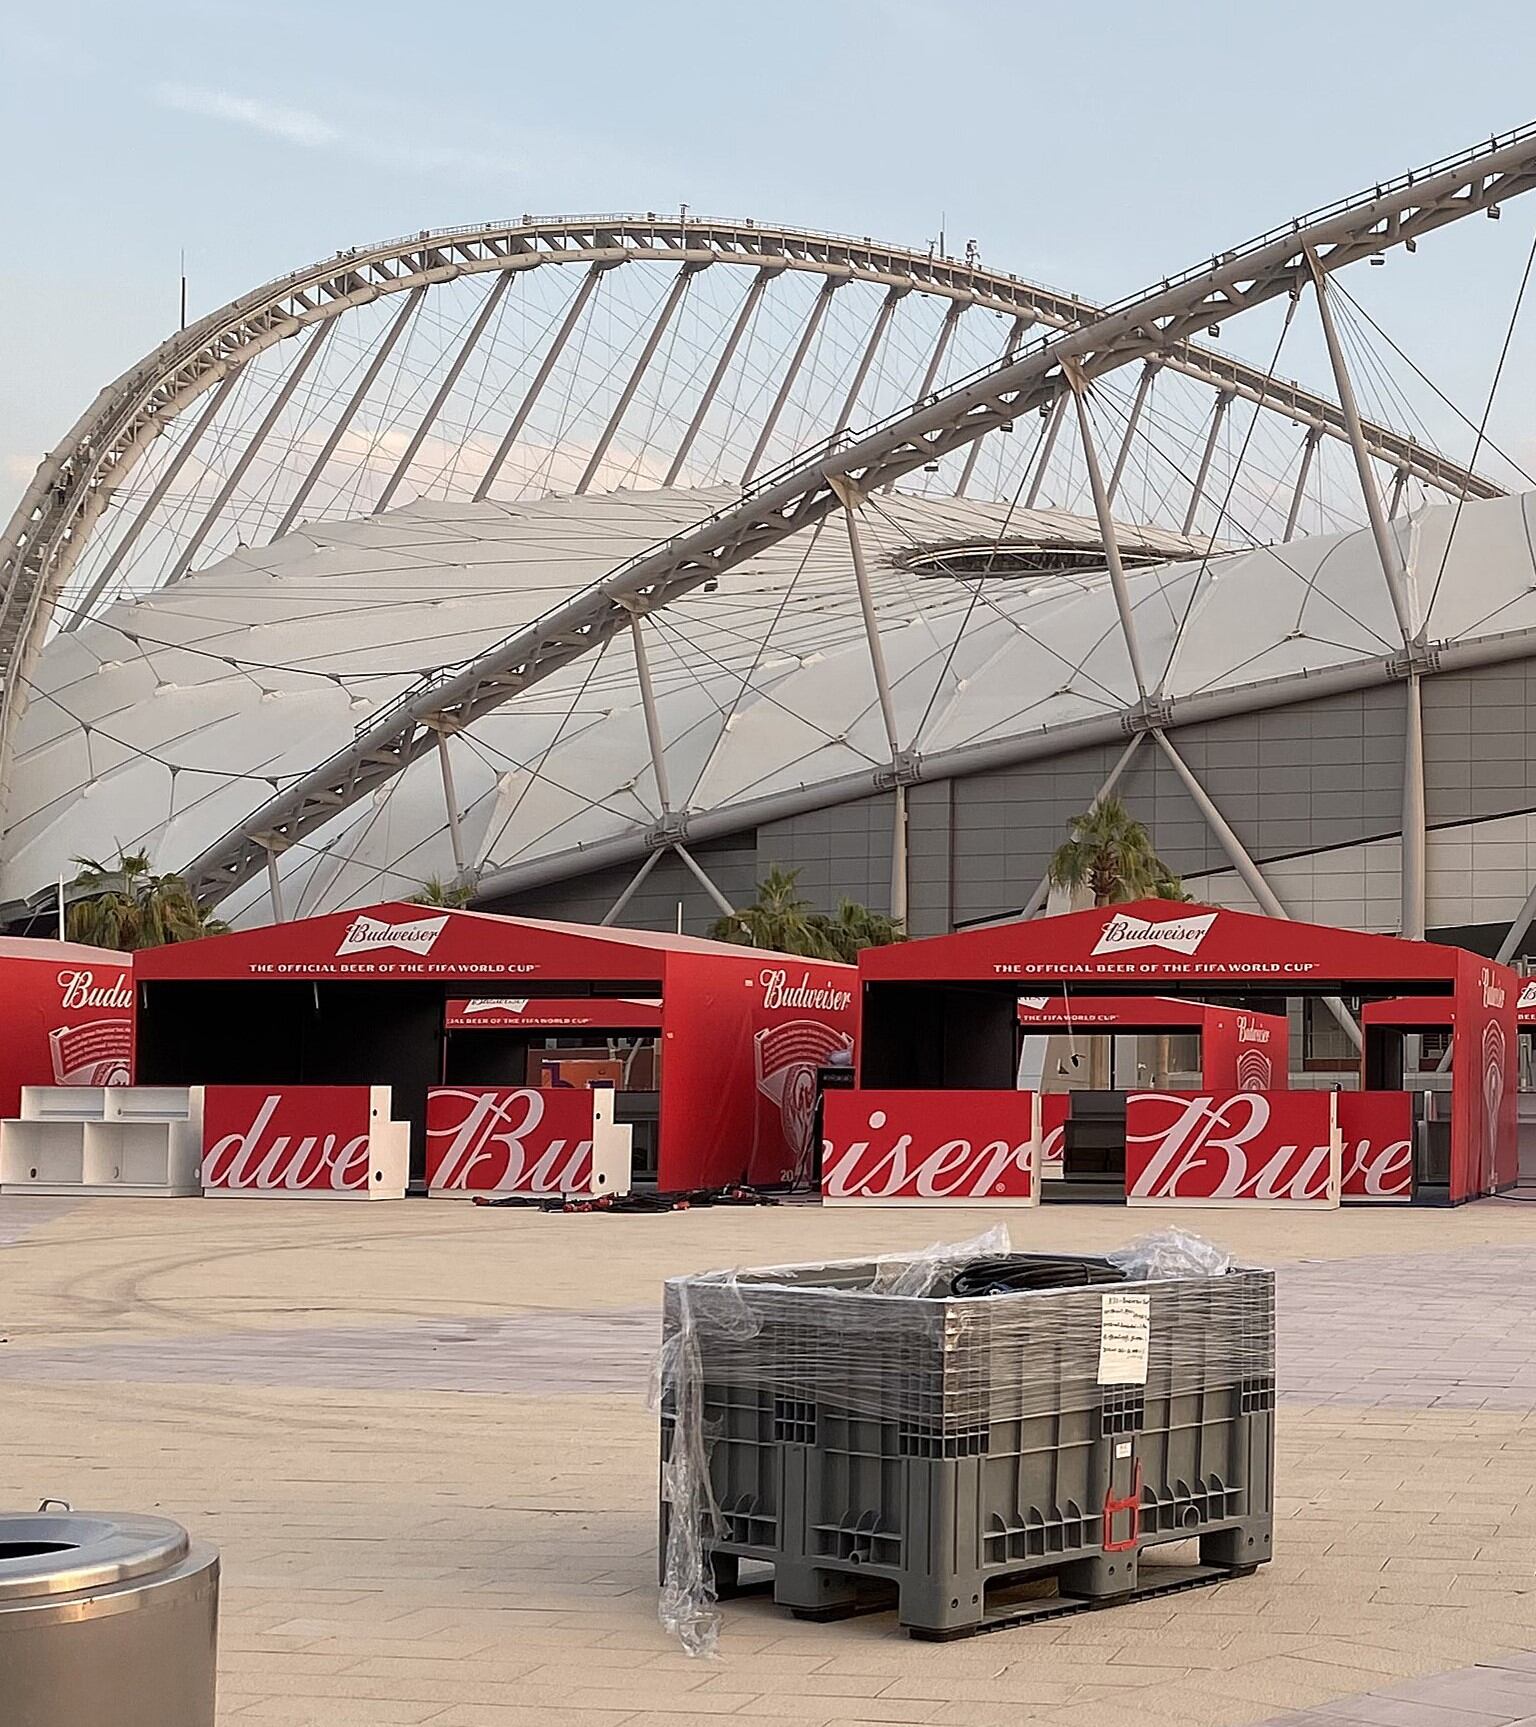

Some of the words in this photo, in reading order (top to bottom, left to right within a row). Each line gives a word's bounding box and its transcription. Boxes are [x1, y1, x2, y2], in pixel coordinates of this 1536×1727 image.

[345, 922, 440, 943] Budweiser
[1101, 922, 1206, 943] Budweiser
[249, 964, 274, 973] THE
[277, 964, 337, 973] OFFICIAL
[340, 964, 375, 973] BEER
[378, 964, 396, 973] OF
[398, 964, 424, 973] THE
[428, 964, 455, 973] FIFA
[457, 964, 505, 973] WORLD
[993, 964, 1022, 973] THE
[1025, 964, 1093, 973] OFFICIAL
[1096, 964, 1135, 973] BEER
[1139, 964, 1159, 973] OF
[1162, 964, 1191, 973] THE
[1194, 964, 1226, 973] FIFA
[1228, 964, 1280, 973] WORLD
[759, 969, 851, 1011] Budweiser
[426, 1089, 594, 1191] Bu
[1126, 1093, 1332, 1200] Bu
